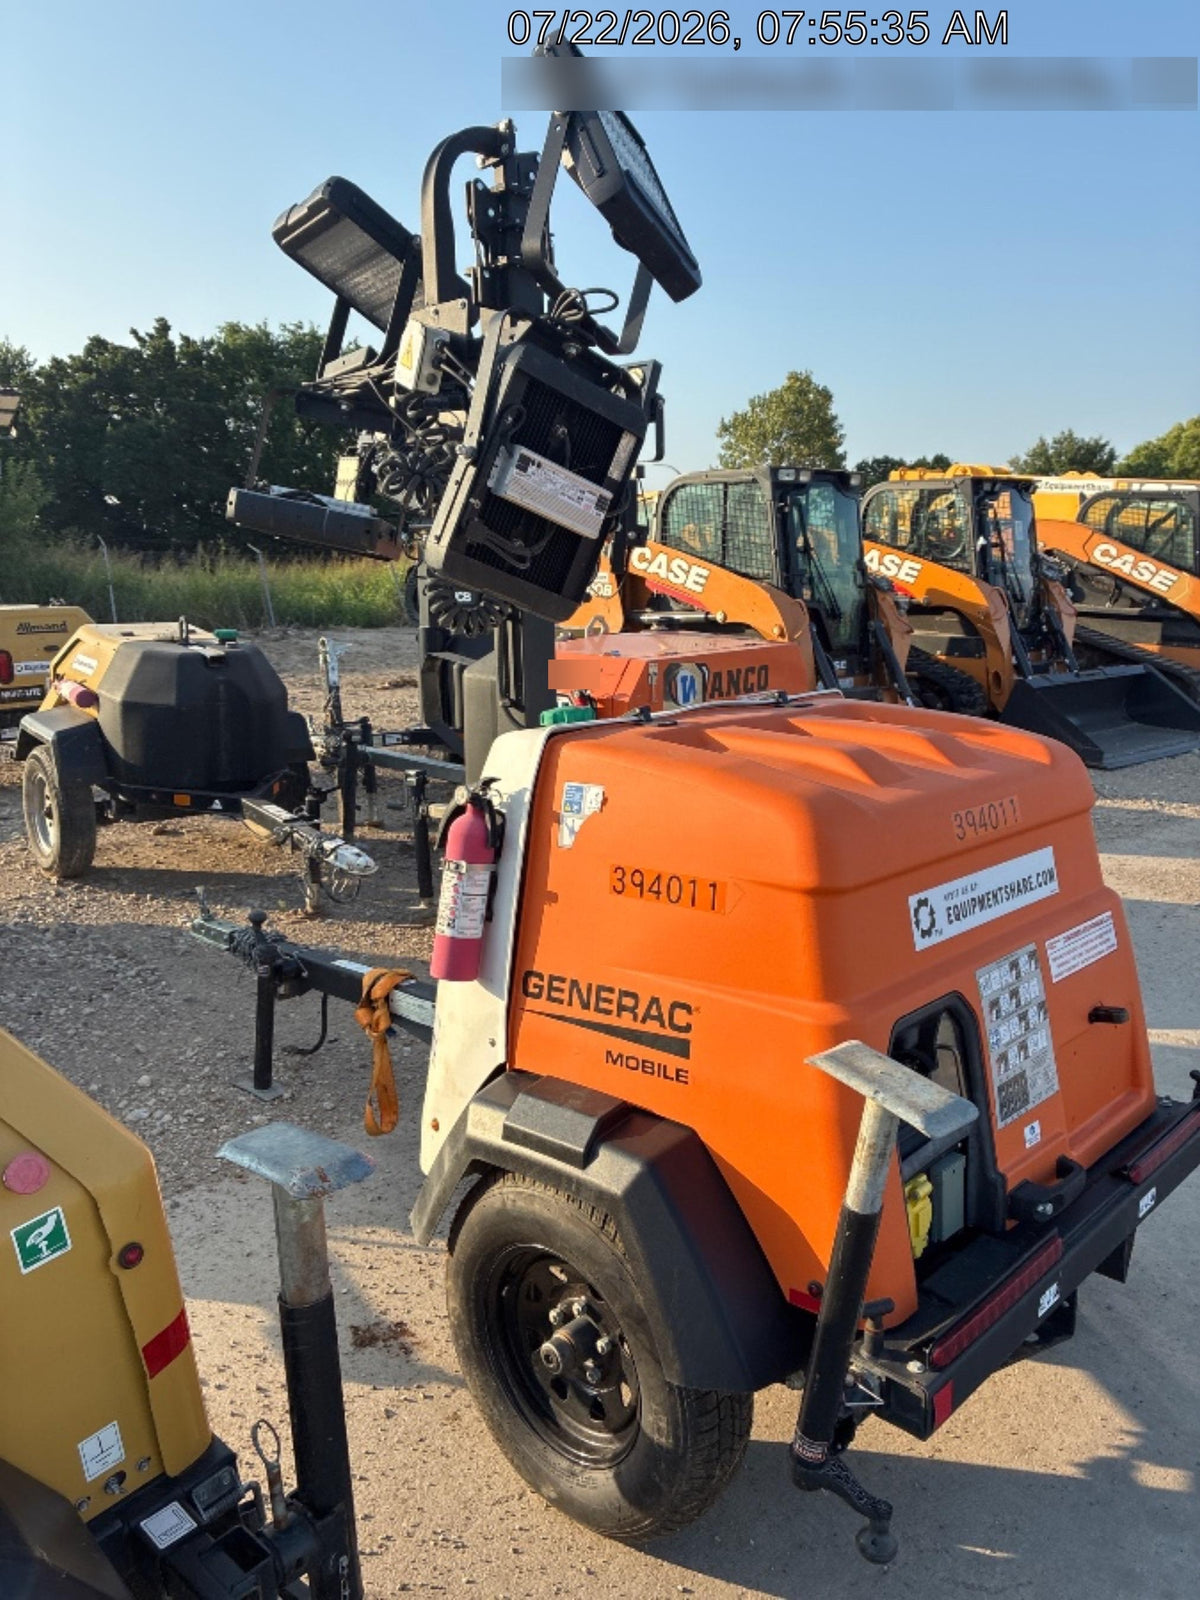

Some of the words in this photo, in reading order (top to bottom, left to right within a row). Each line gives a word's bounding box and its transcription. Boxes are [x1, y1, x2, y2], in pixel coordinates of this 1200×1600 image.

[630, 546, 710, 593] CASE
[864, 549, 922, 584] ASE
[1093, 543, 1179, 592] CASE
[954, 798, 1018, 840] 394011
[612, 866, 718, 911] 394011
[946, 867, 1055, 925] EQUIPMENTSHARE.COM
[522, 969, 693, 1034] GENERAC
[605, 1050, 689, 1085] MOBILE
